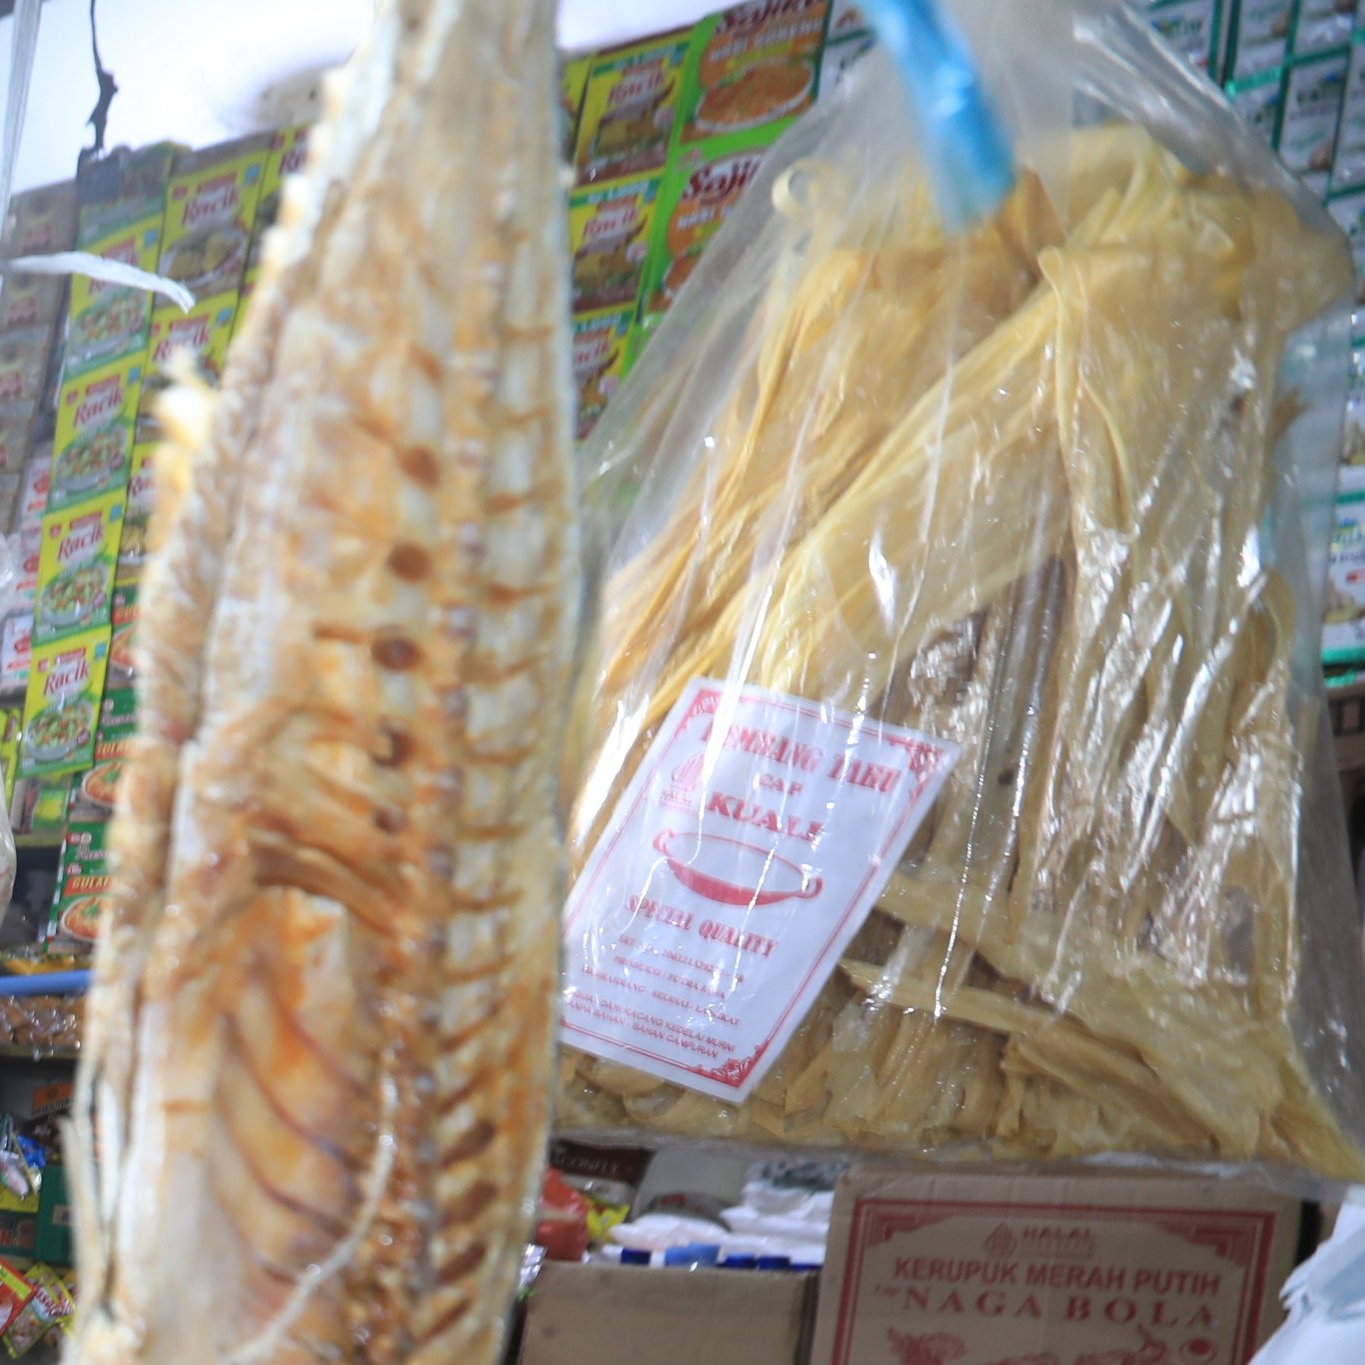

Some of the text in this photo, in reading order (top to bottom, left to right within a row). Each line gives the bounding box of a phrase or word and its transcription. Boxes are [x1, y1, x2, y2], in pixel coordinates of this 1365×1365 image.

[682, 157, 765, 199] Saji
[57, 524, 103, 562] Racik
[43, 659, 88, 696] Racik
[758, 773, 803, 797] CAP
[708, 791, 824, 842] KUALI
[625, 894, 779, 958] SPECIAL QUALITY
[893, 1255, 1222, 1299] KERUPUK MERAH PUTIH
[902, 1287, 1042, 1320] NAGA
[1064, 1293, 1214, 1330] BOLA
